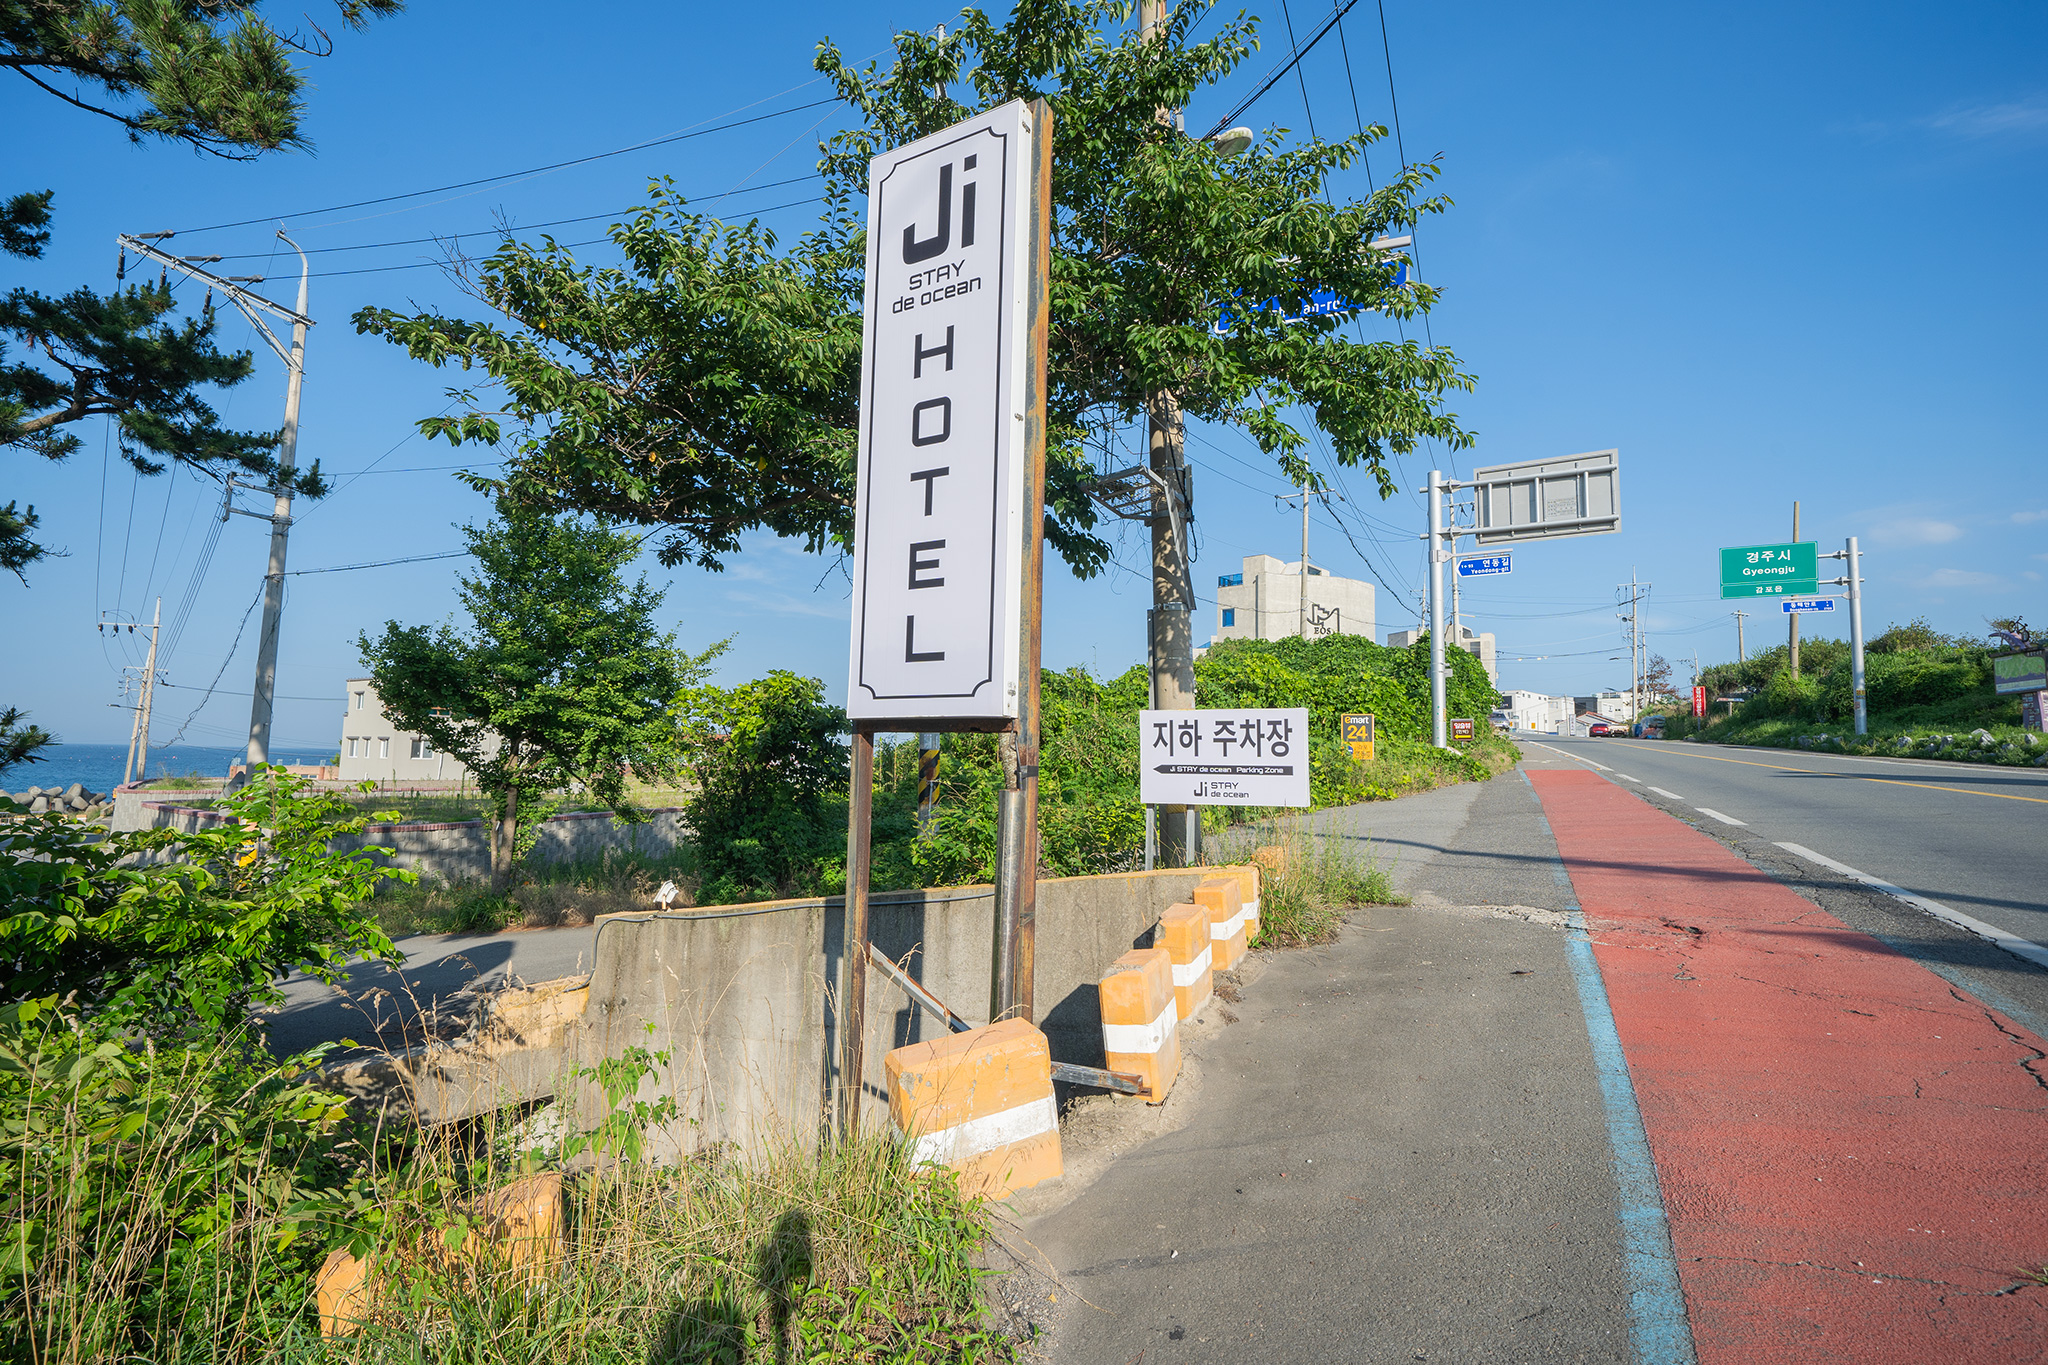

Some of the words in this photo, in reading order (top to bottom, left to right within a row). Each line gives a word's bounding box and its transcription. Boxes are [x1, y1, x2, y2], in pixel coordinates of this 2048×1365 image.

[902, 153, 977, 265] Ji
[909, 259, 965, 291] STAY
[892, 296, 915, 314] de
[920, 277, 981, 306] ocean
[905, 324, 954, 663] HOTEL
[1483, 558, 1509, 567] 연동길
[1746, 549, 1791, 563] 경주시
[1742, 566, 1795, 576] Gyeongju
[1344, 716, 1370, 724] emart
[1152, 719, 1203, 757] 지하
[1212, 718, 1293, 757] 주차장
[1347, 725, 1368, 739] 24
[1177, 765, 1198, 773] STAY
[1236, 766, 1264, 775] Parking
[1193, 782, 1208, 797] Ji
[1210, 790, 1221, 798] de
